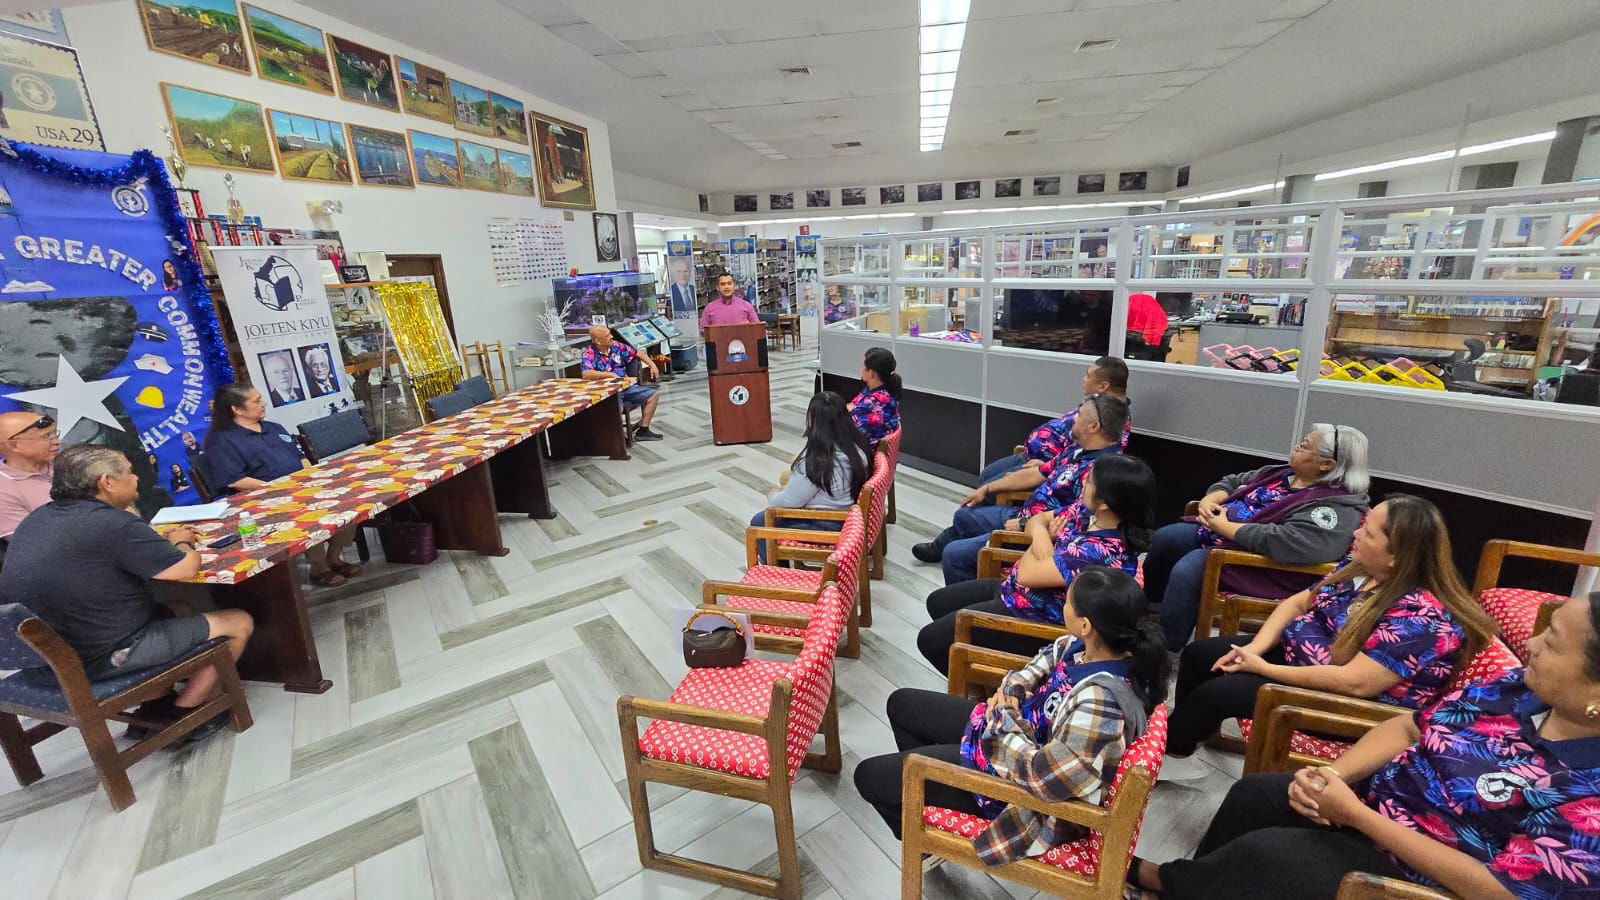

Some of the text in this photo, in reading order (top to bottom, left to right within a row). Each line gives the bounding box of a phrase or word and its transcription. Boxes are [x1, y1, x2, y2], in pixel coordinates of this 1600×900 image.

[14, 235, 157, 292] GREATER
[244, 320, 297, 340] JOETEN
[300, 316, 330, 331] KIYU
[139, 295, 205, 452] COMMONWEALTH
